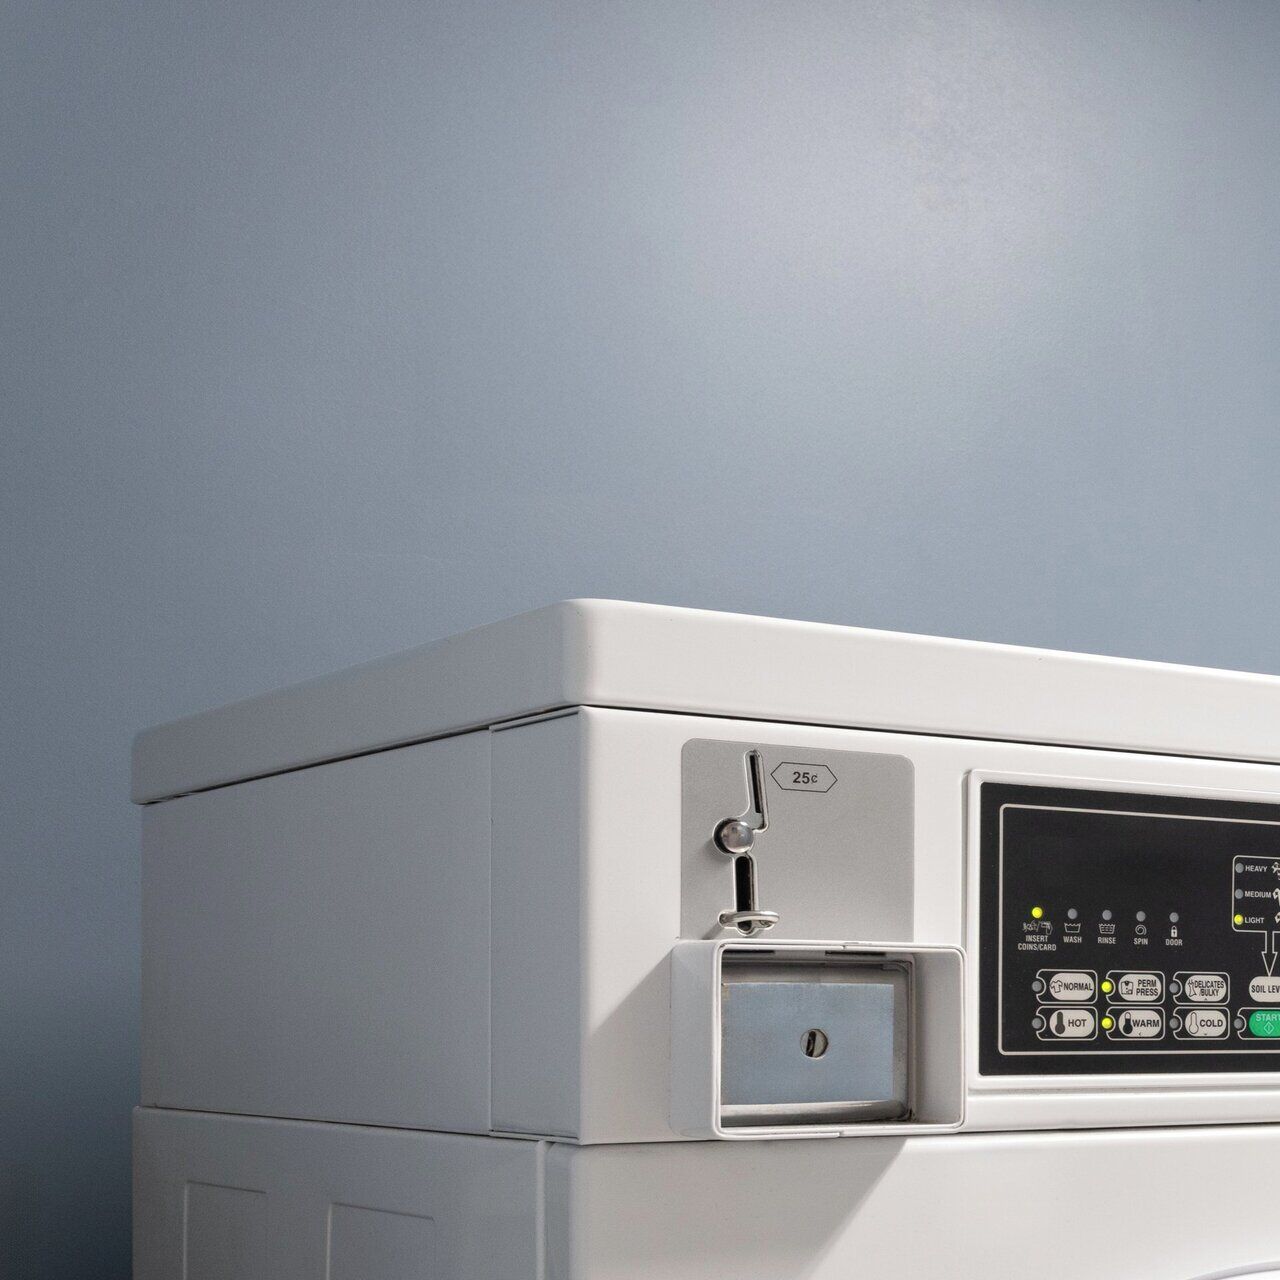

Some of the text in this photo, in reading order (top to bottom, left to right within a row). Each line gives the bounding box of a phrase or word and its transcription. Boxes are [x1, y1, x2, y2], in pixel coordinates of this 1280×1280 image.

[792, 771, 818, 784] 25¢
[1025, 935, 1048, 943] INSERT
[1063, 936, 1083, 944] WASH
[1097, 937, 1117, 945] RINSE
[1017, 943, 1057, 951] COINS/CARD
[1063, 982, 1093, 991] NORMAL
[1194, 980, 1225, 988] DELICATES
[1136, 988, 1159, 996] PRESS
[1200, 988, 1219, 997] /BULKY
[1251, 985, 1266, 993] SOIL
[1255, 1013, 1280, 1022] START
[1068, 1019, 1087, 1027] HOT
[1133, 1019, 1160, 1028] WARM
[1200, 1019, 1223, 1028] COLD
